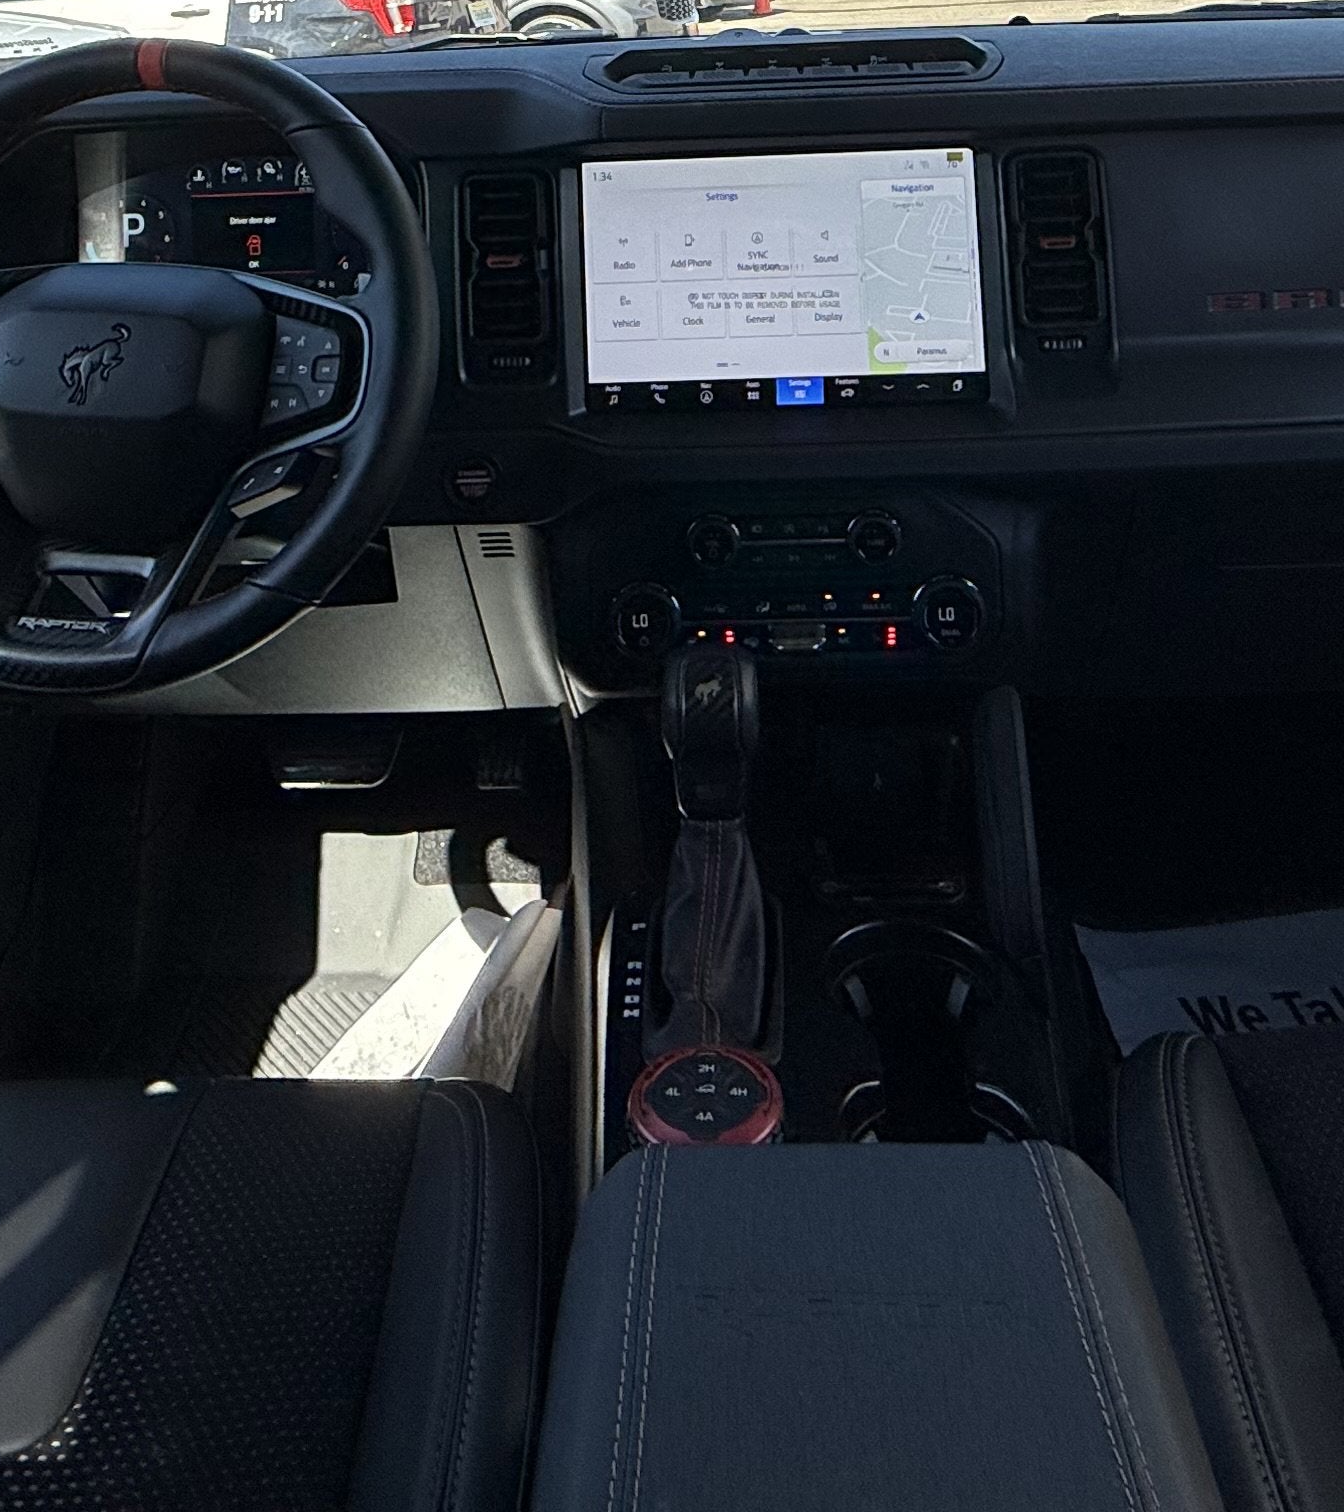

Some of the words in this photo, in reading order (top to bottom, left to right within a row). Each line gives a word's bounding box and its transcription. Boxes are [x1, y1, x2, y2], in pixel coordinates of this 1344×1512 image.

[891, 184, 935, 193] Navigation
[705, 192, 739, 202] Settings
[229, 217, 248, 225] Driver
[122, 212, 145, 248] P
[747, 250, 768, 259] SYNC
[813, 254, 839, 263] Sound
[248, 260, 260, 268] OK
[613, 261, 636, 270] Radio
[670, 259, 685, 268] Add
[687, 258, 712, 267] Phone
[682, 317, 704, 326] Clock
[745, 314, 776, 324] General
[814, 312, 843, 323] Display
[612, 319, 641, 328] Vehicle
[17, 616, 110, 634] RAPTOR
[1177, 995, 1269, 1035] We
[697, 1064, 715, 1073] 2H
[665, 1087, 681, 1097] 4L
[729, 1087, 748, 1097] 4H
[695, 1112, 714, 1121] 4A
